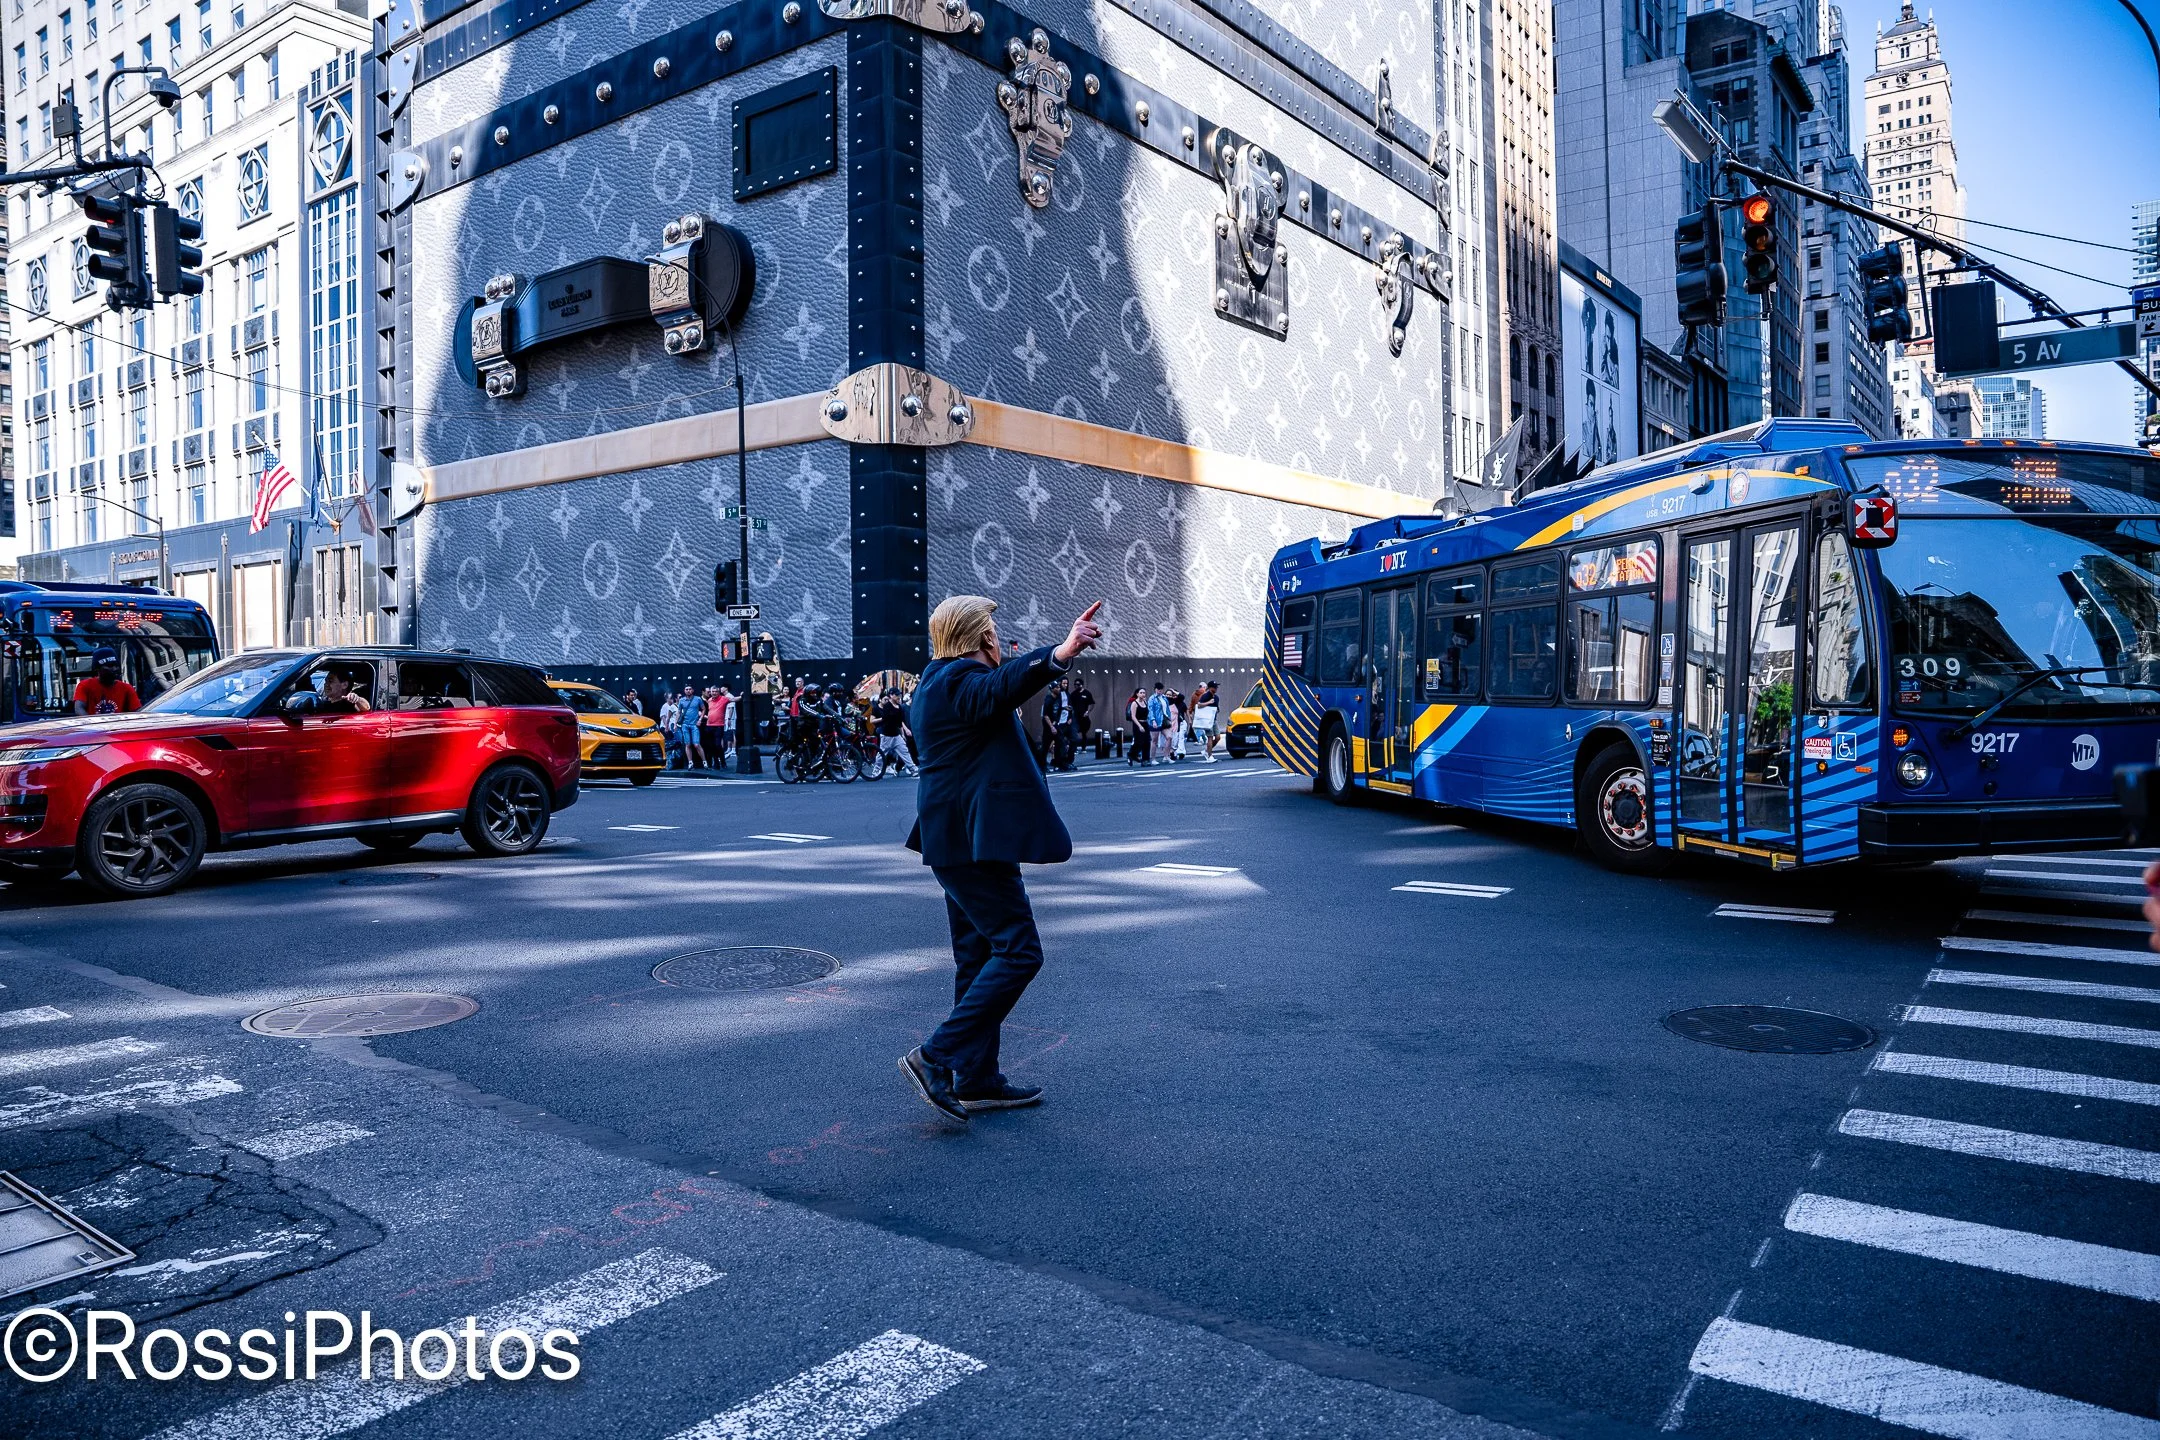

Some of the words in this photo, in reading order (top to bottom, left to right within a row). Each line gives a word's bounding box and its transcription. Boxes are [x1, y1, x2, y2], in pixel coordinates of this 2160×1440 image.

[2013, 343, 2027, 364] 5
[2036, 340, 2062, 362] Av
[1662, 494, 1686, 514] 9217
[1804, 738, 1832, 747] CAUTION
[1971, 732, 2020, 753] 9217
[2071, 741, 2096, 764] MTA
